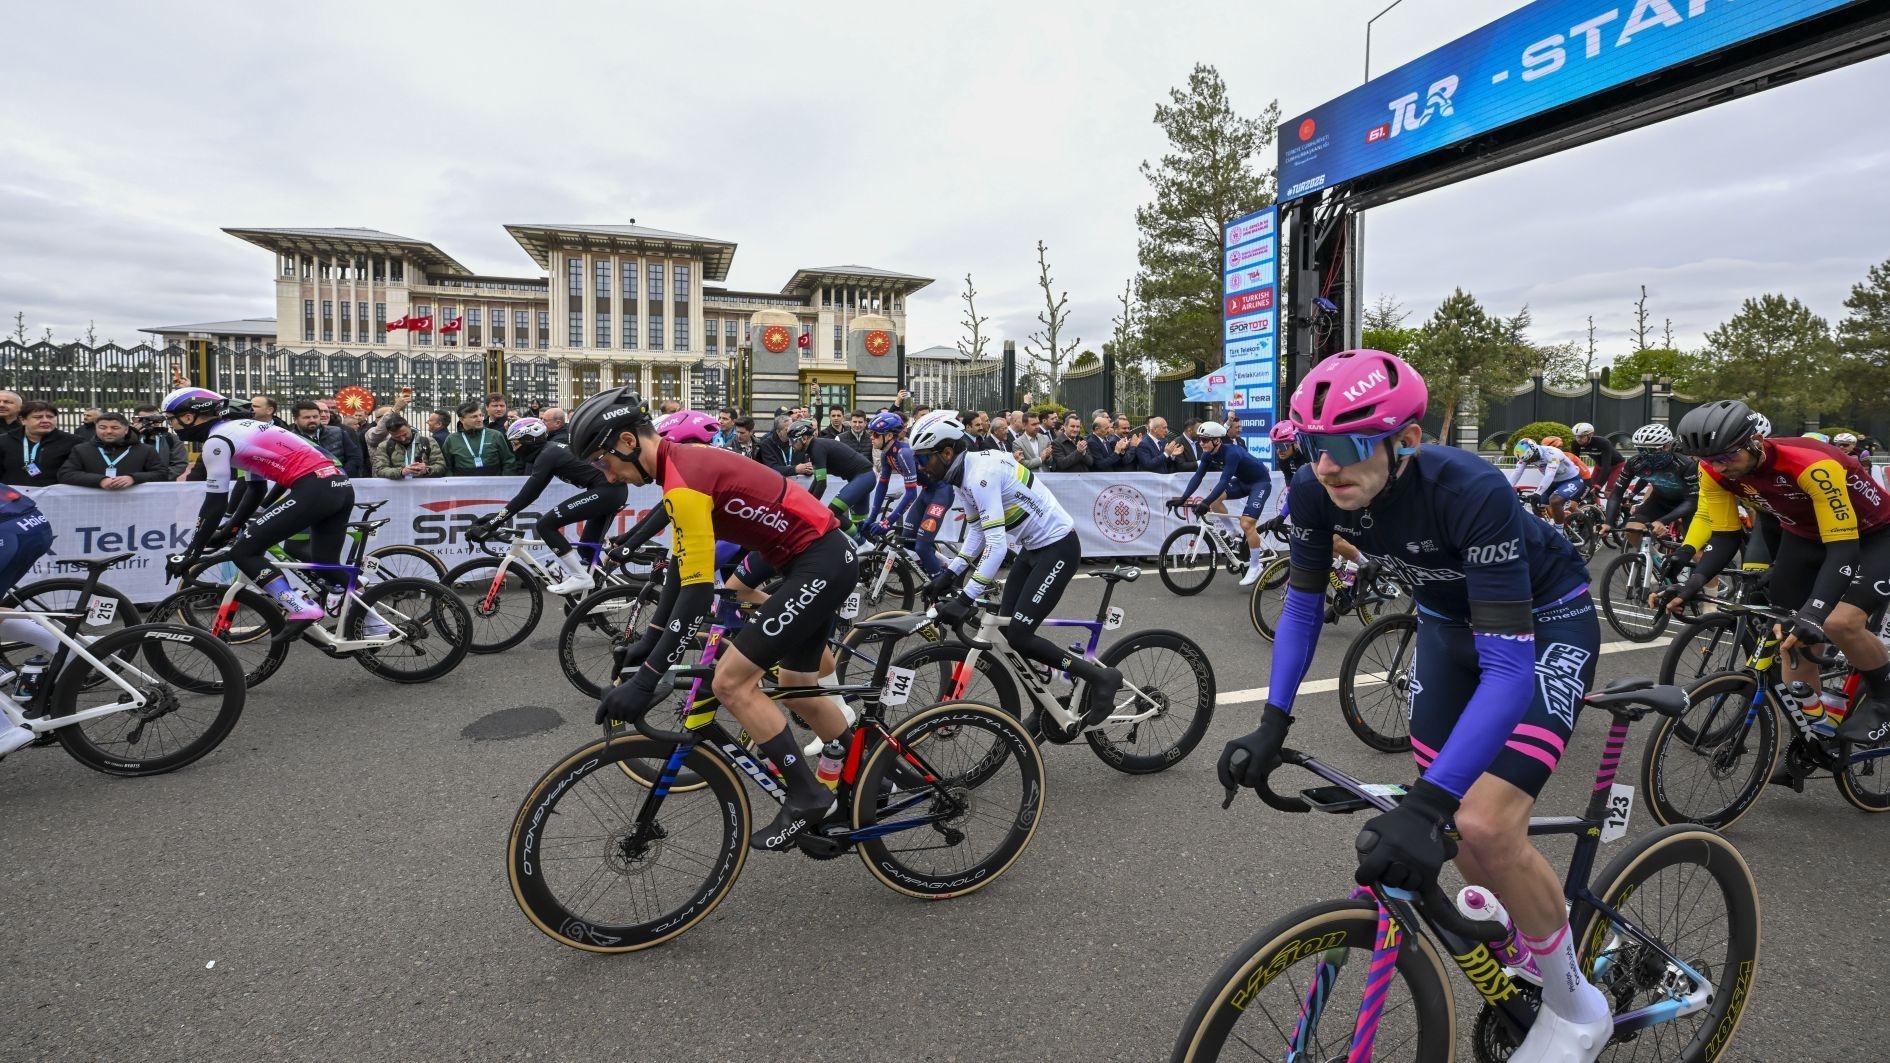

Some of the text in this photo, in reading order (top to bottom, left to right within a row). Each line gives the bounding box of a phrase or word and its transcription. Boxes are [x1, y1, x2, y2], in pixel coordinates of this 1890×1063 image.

[1368, 126, 1386, 141] 61.
[1287, 174, 1326, 196] #TUR2026
[1242, 291, 1270, 303] TURKISH
[1242, 299, 1270, 311] AIRLINES
[602, 406, 630, 421] uvex
[1241, 419, 1265, 427] IMANO
[567, 494, 599, 510] SIROKO
[1810, 468, 1850, 521] Cofidis
[16, 514, 47, 531] Haie
[256, 499, 297, 526] SIROKO
[724, 498, 790, 533] Cofidis
[75, 524, 191, 554] Telek
[1291, 527, 1313, 541] OSE
[1466, 537, 1521, 565] ROSE
[1032, 559, 1065, 604] SIROKO
[97, 602, 114, 620] 215
[762, 578, 828, 637] Cofidis
[847, 596, 858, 613] 125
[1538, 604, 1592, 623] OneBlade
[1014, 611, 1034, 626] BH
[1109, 612, 1121, 625] 34
[667, 615, 704, 663] Cofidis
[892, 675, 911, 698] 144
[1004, 652, 1046, 694] BH
[1775, 682, 1819, 742] LOOK
[906, 713, 1028, 755] BORA ULTRA WTO
[1867, 720, 1890, 741] Cofi
[722, 743, 787, 804] LOOK
[523, 758, 599, 876] CAMPAGNOLO
[1608, 796, 1630, 829] 123
[765, 818, 807, 848] Cofidis
[654, 801, 738, 933] BORA ULTRA WTO
[881, 860, 986, 889] CAMPAGNOLO
[1452, 942, 1523, 1007] ROSE
[1566, 971, 1576, 993] Philips
